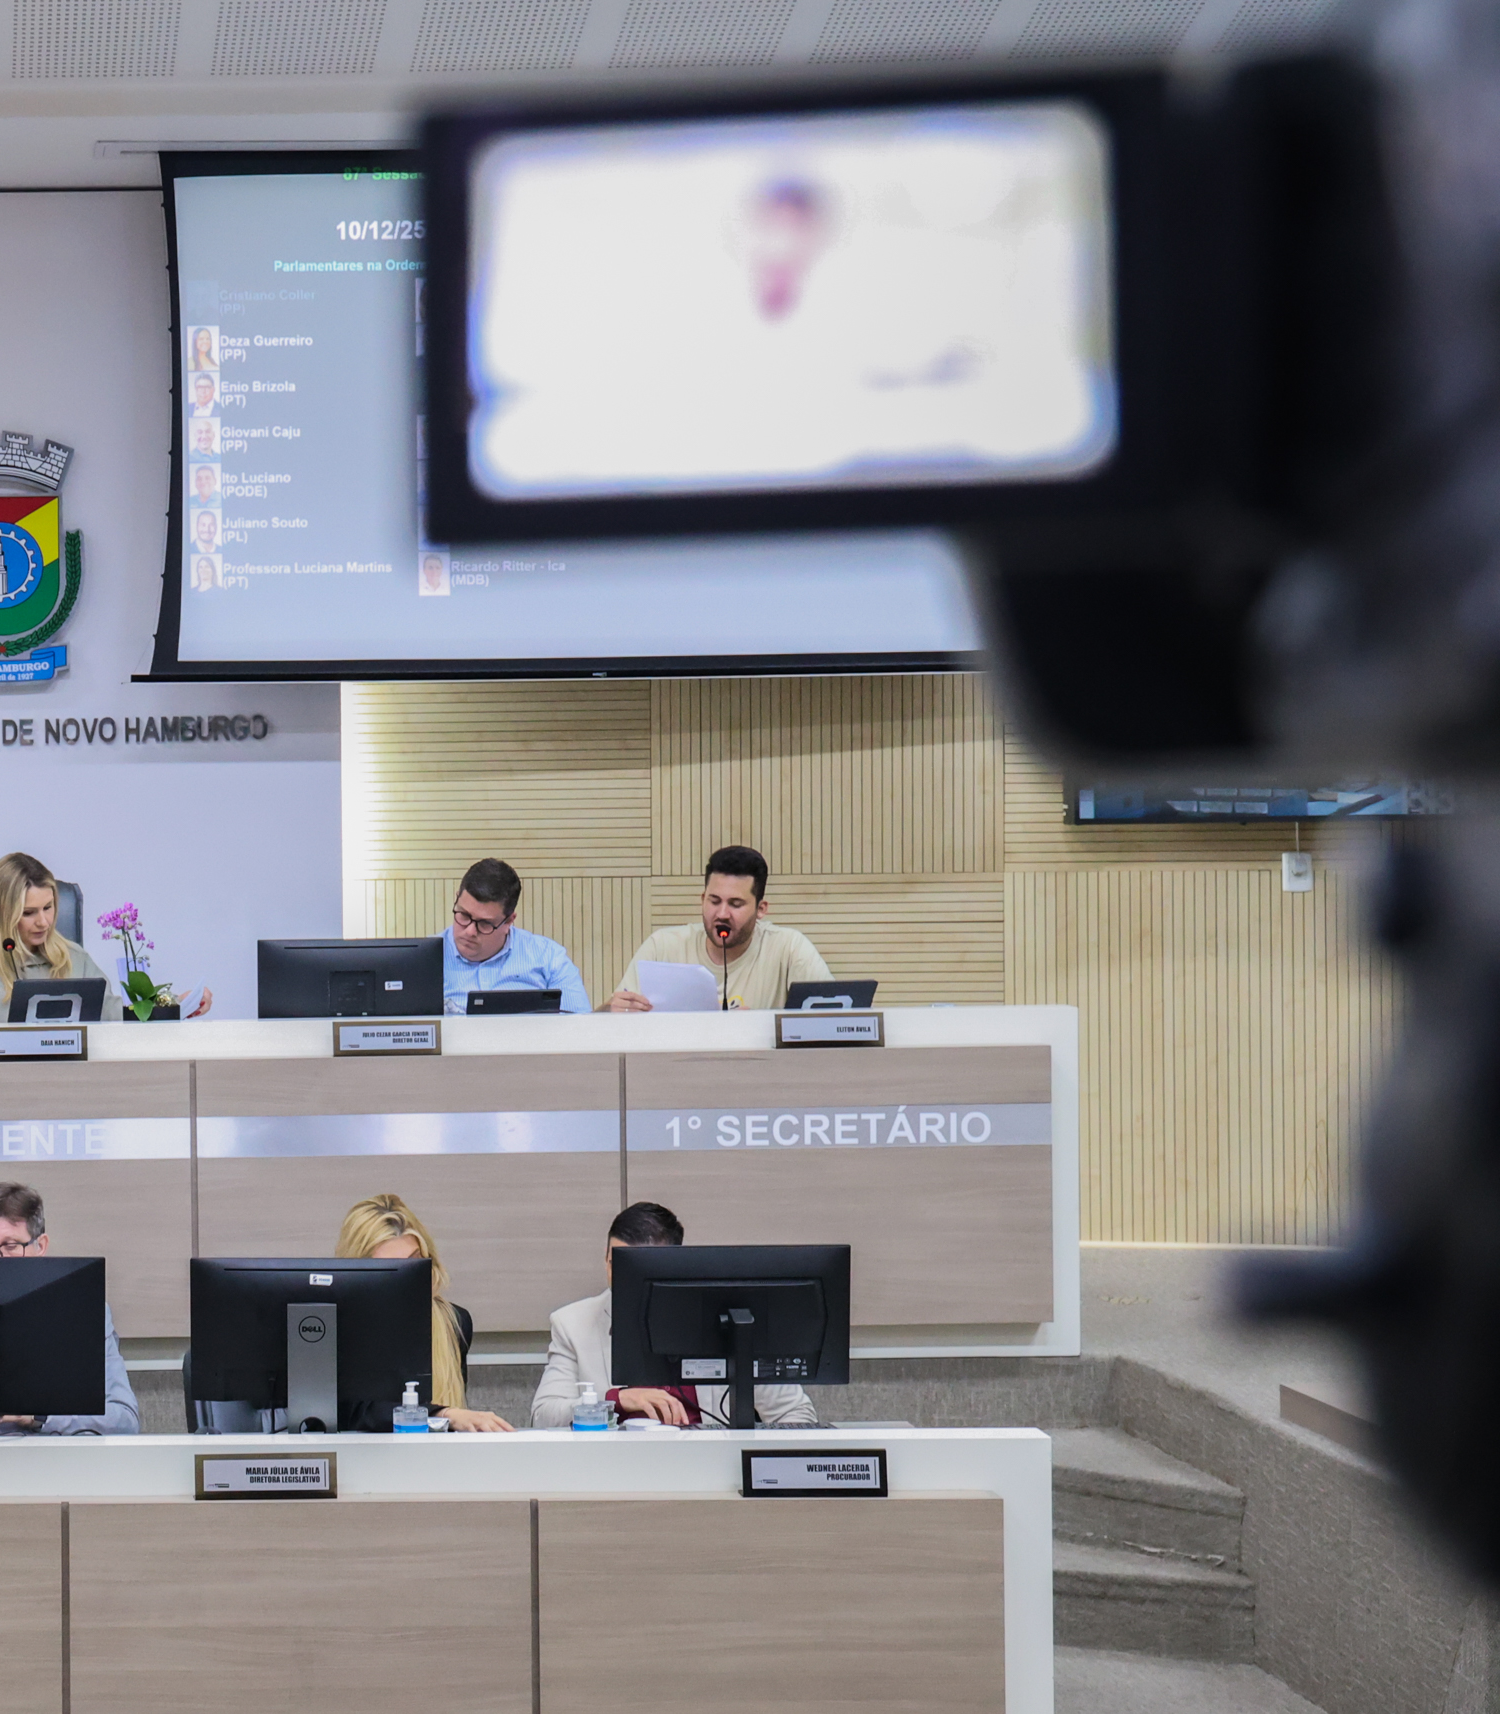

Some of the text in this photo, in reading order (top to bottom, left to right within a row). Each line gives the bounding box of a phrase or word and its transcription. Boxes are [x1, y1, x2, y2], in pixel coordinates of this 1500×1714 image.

[274, 260, 363, 272] Parlamentares
[367, 262, 382, 271] na
[219, 289, 315, 300] Cristiano Coller
[220, 334, 313, 347] Deza Guerreiro
[220, 349, 246, 362] (PP)
[220, 380, 296, 393] Enio Brizola
[221, 395, 246, 408] (PT)
[221, 426, 301, 440] Giovani Caju
[221, 440, 247, 453] (PP)
[222, 472, 291, 484] Ito Luciano
[222, 485, 267, 499] (PODE)
[222, 517, 308, 529] Juliano Souto
[223, 531, 248, 544] (PL)
[223, 561, 392, 574] Professora Luciana Martins
[451, 561, 499, 572] Ricardo
[503, 560, 536, 571] Ritter
[223, 576, 248, 589] (PT)
[451, 574, 489, 587] (MDB)
[2, 718, 34, 746] DE
[45, 716, 117, 745] NOVO
[125, 713, 268, 744] HAMBURGO
[716, 1106, 992, 1147] SECRETÁRIO
[245, 1465, 320, 1475] MARIA JÚLIA DE ÁVILA
[807, 1464, 870, 1472] WEDNER LACERDA
[250, 1475, 320, 1484] DIRETORA LEGISLATIVO
[827, 1473, 870, 1481] PROCURADOR
